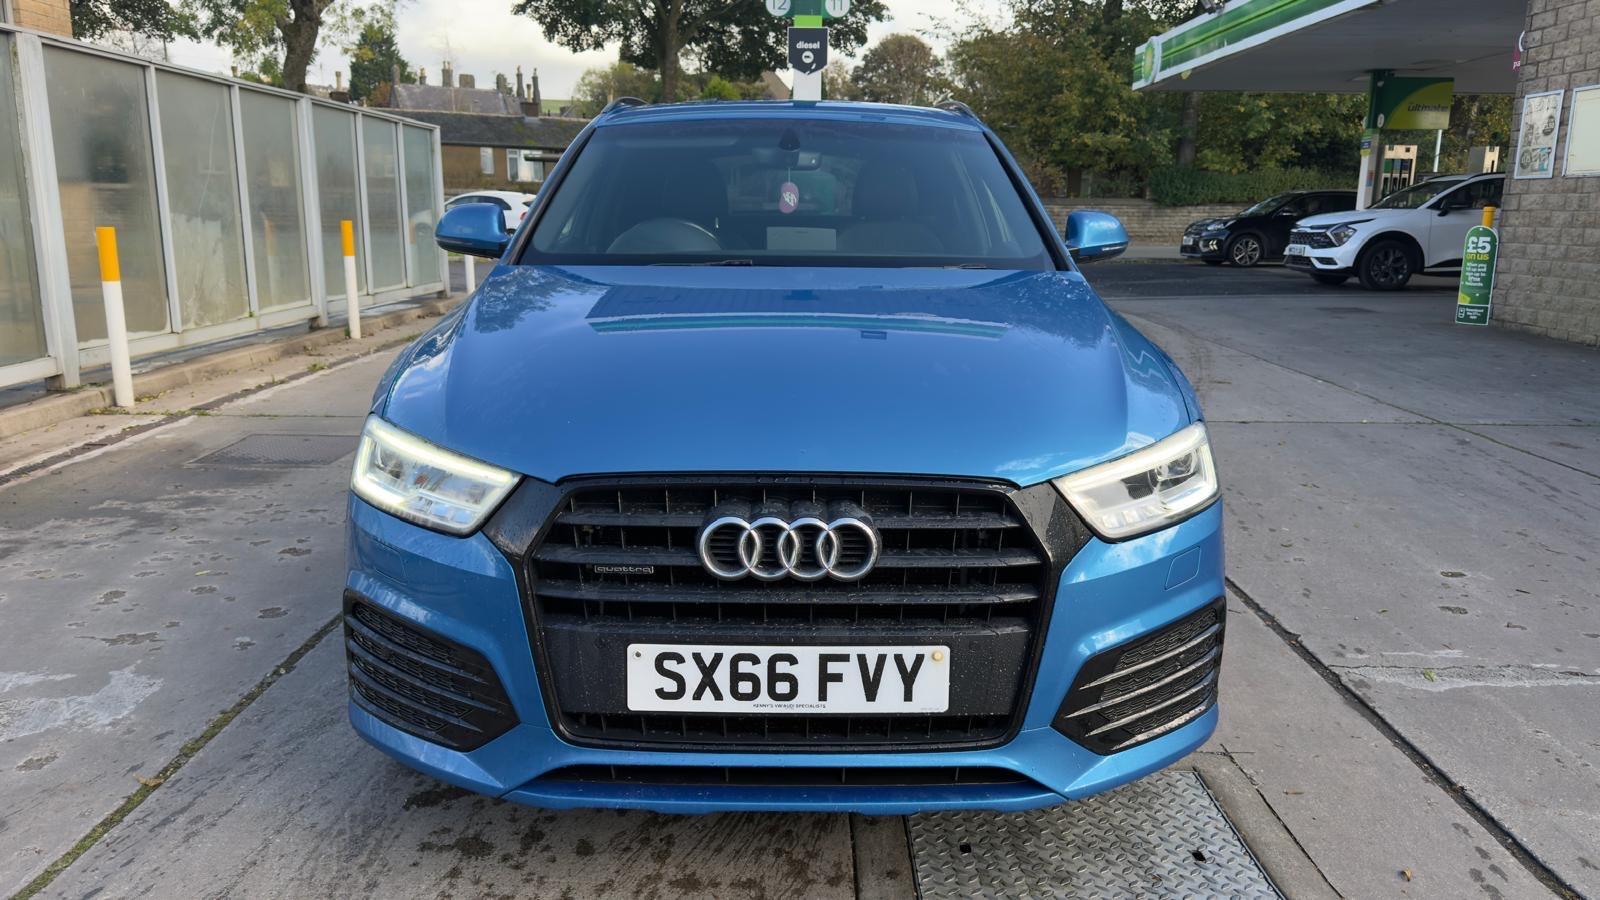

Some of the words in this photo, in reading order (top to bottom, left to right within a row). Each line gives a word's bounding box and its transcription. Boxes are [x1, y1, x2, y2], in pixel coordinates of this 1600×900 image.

[772, 0, 787, 10] 12
[831, 0, 843, 11] 11
[796, 41, 820, 49] diesel
[1467, 236, 1491, 254] £5
[597, 566, 652, 574] quattro
[654, 651, 799, 702] SX66
[818, 653, 925, 703] FVY
